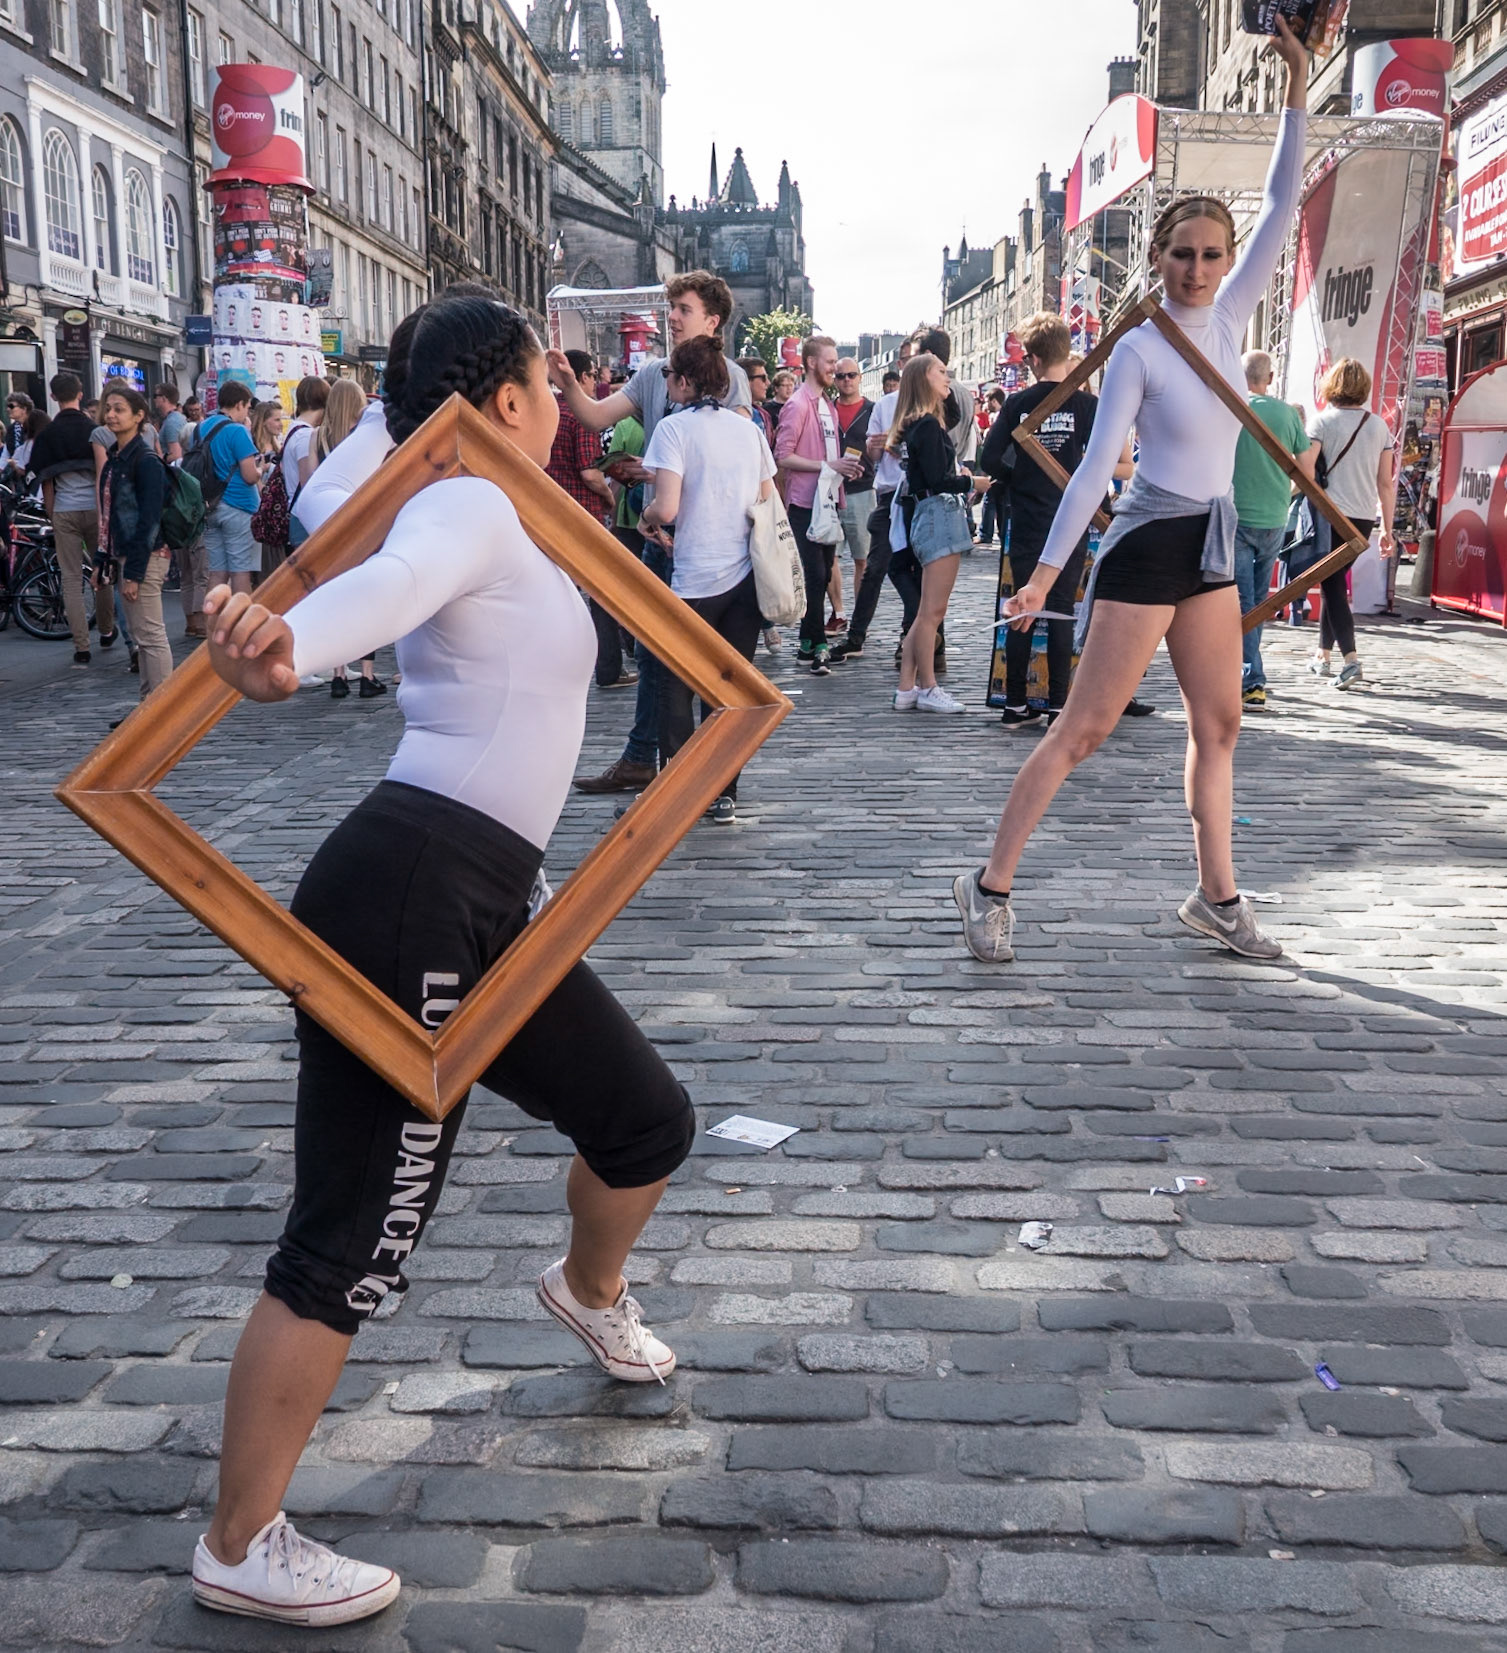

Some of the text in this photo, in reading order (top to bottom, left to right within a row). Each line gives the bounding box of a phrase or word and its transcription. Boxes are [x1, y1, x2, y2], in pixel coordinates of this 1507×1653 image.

[1411, 88, 1440, 99] money
[235, 111, 266, 122] money
[1089, 151, 1105, 187] fringe
[1321, 265, 1374, 328] fringe
[101, 318, 112, 331] OF
[116, 322, 147, 342] BENGAL
[1461, 466, 1491, 506] fringe
[1467, 544, 1487, 561] money
[371, 1121, 444, 1262] DANCE
